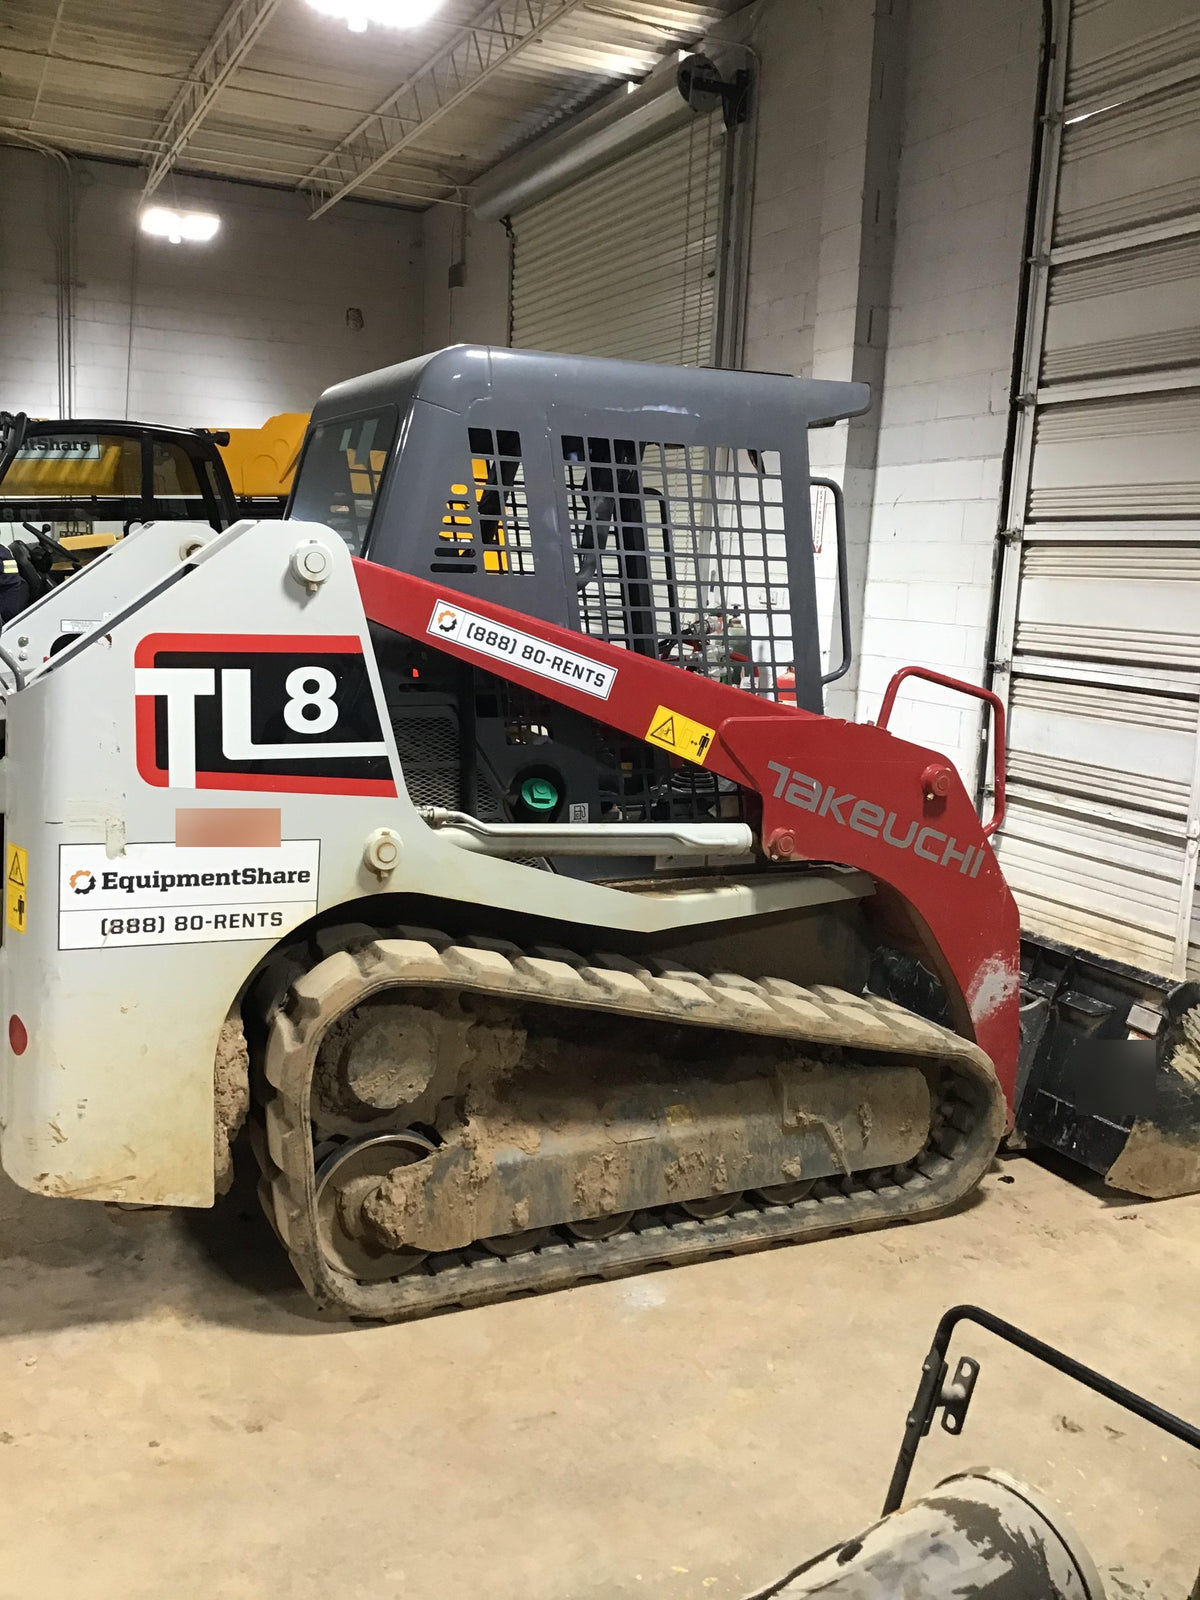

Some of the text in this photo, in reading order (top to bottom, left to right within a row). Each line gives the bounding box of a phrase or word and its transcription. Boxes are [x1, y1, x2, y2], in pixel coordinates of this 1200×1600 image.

[466, 622, 606, 688] (888) 80-RENTS
[101, 868, 310, 893] EquipmentShare
[101, 912, 283, 936] (888) 80-RENTS
